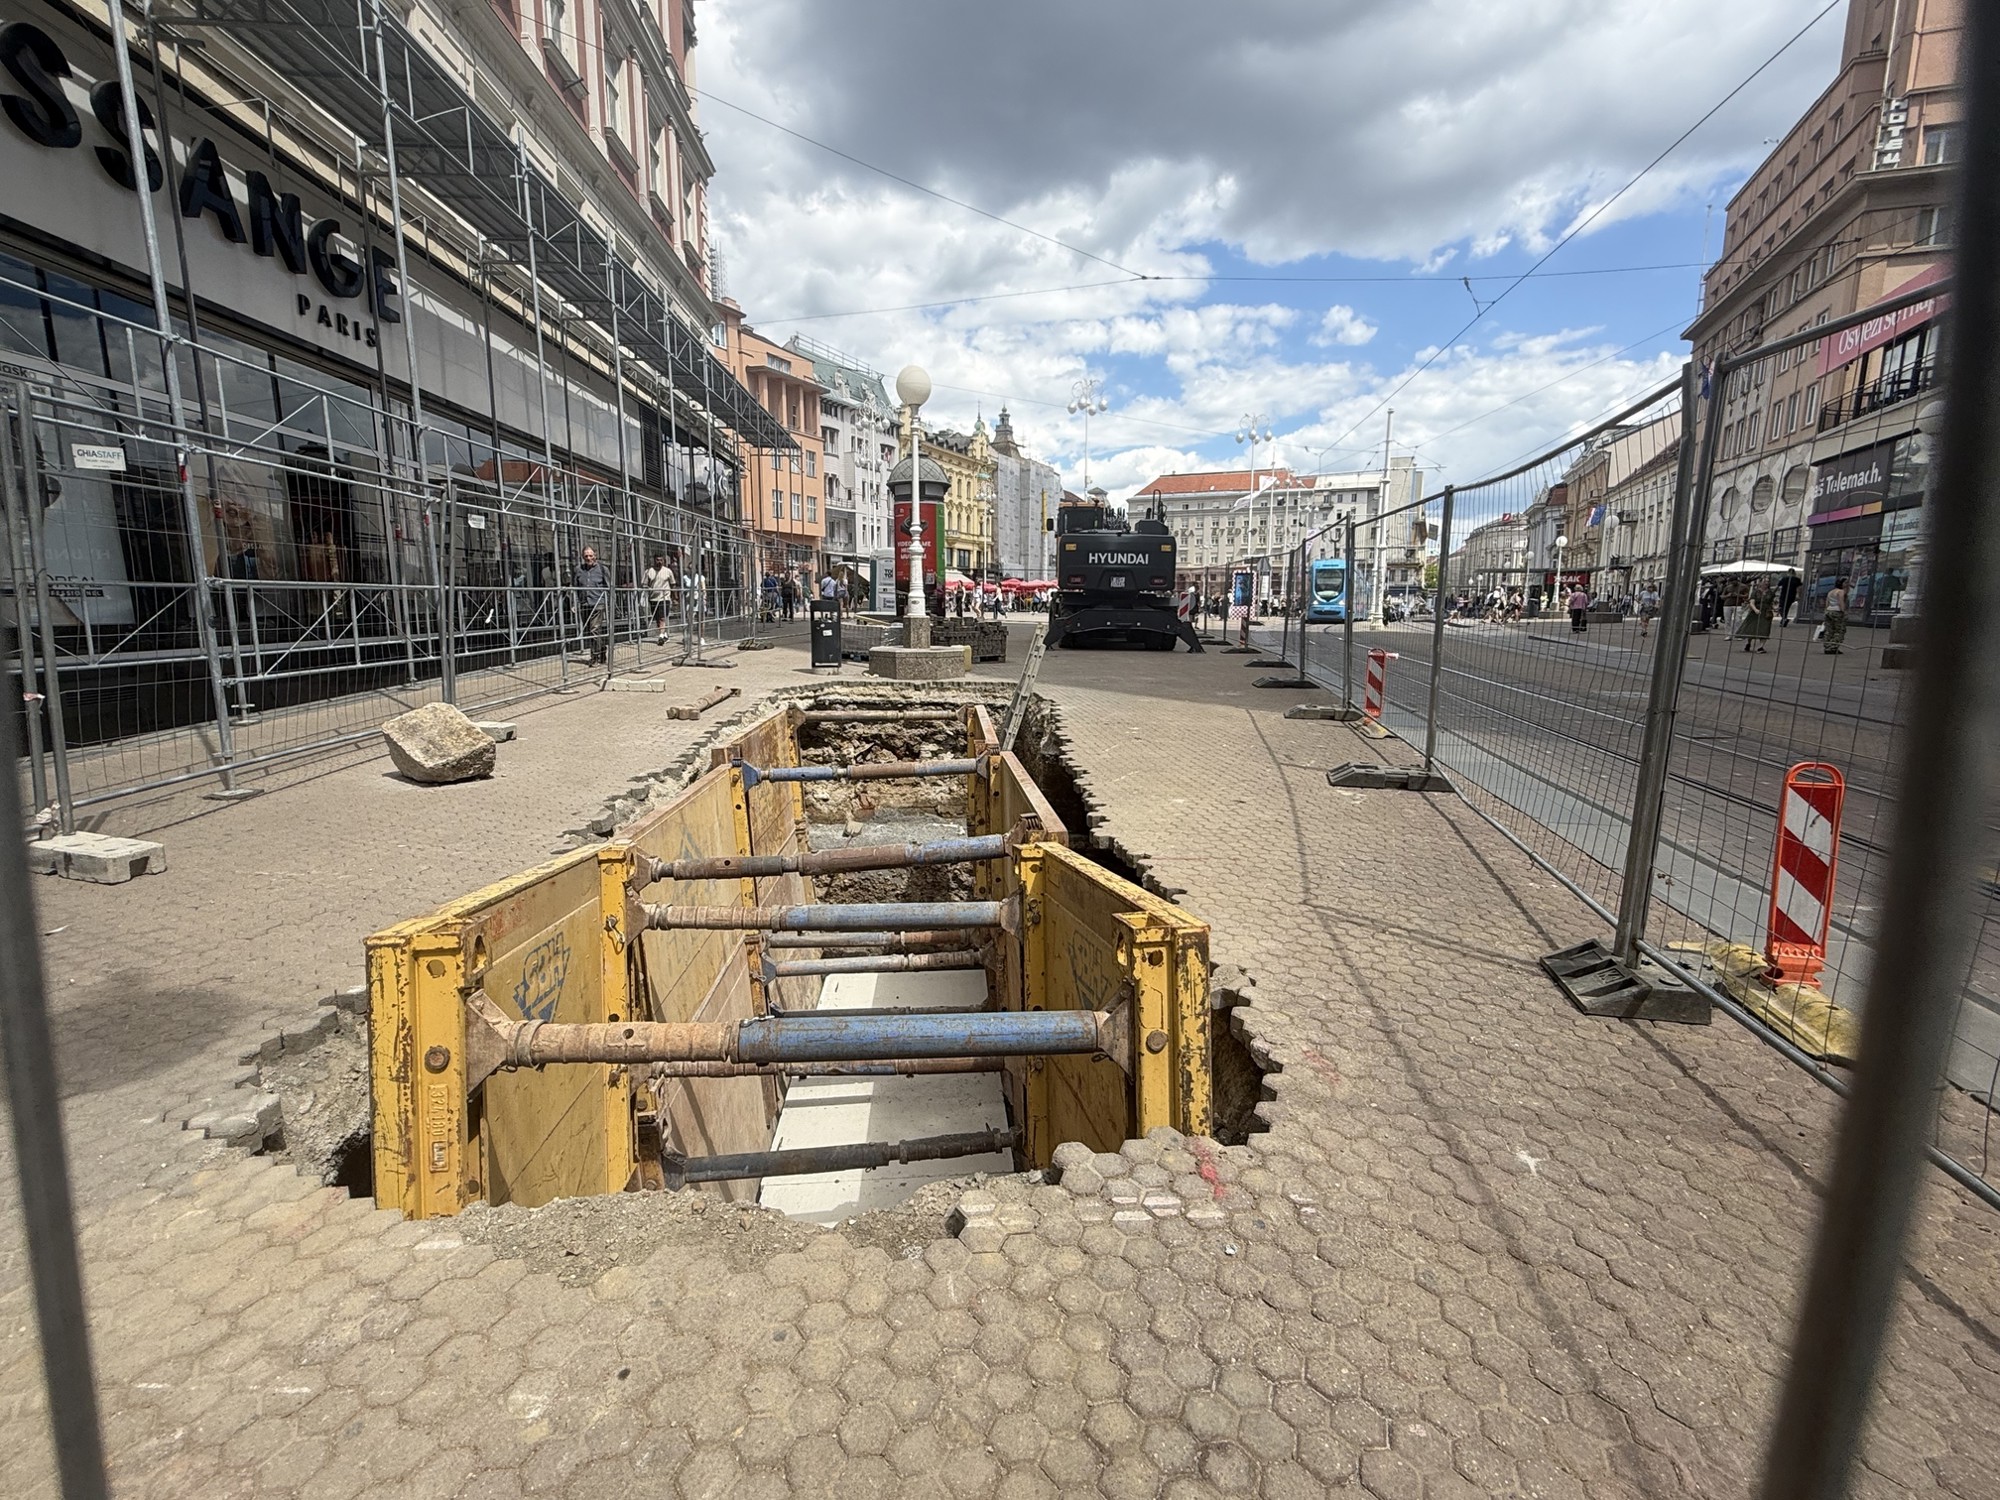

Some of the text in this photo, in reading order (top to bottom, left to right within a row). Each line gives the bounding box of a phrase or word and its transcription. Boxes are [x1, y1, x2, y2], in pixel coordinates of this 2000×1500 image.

[297, 293, 377, 348] PARIS
[77, 448, 123, 460] CHIASTAFF
[1088, 553, 1149, 565] HYUNDAI
[1554, 575, 1581, 583] TSAK
